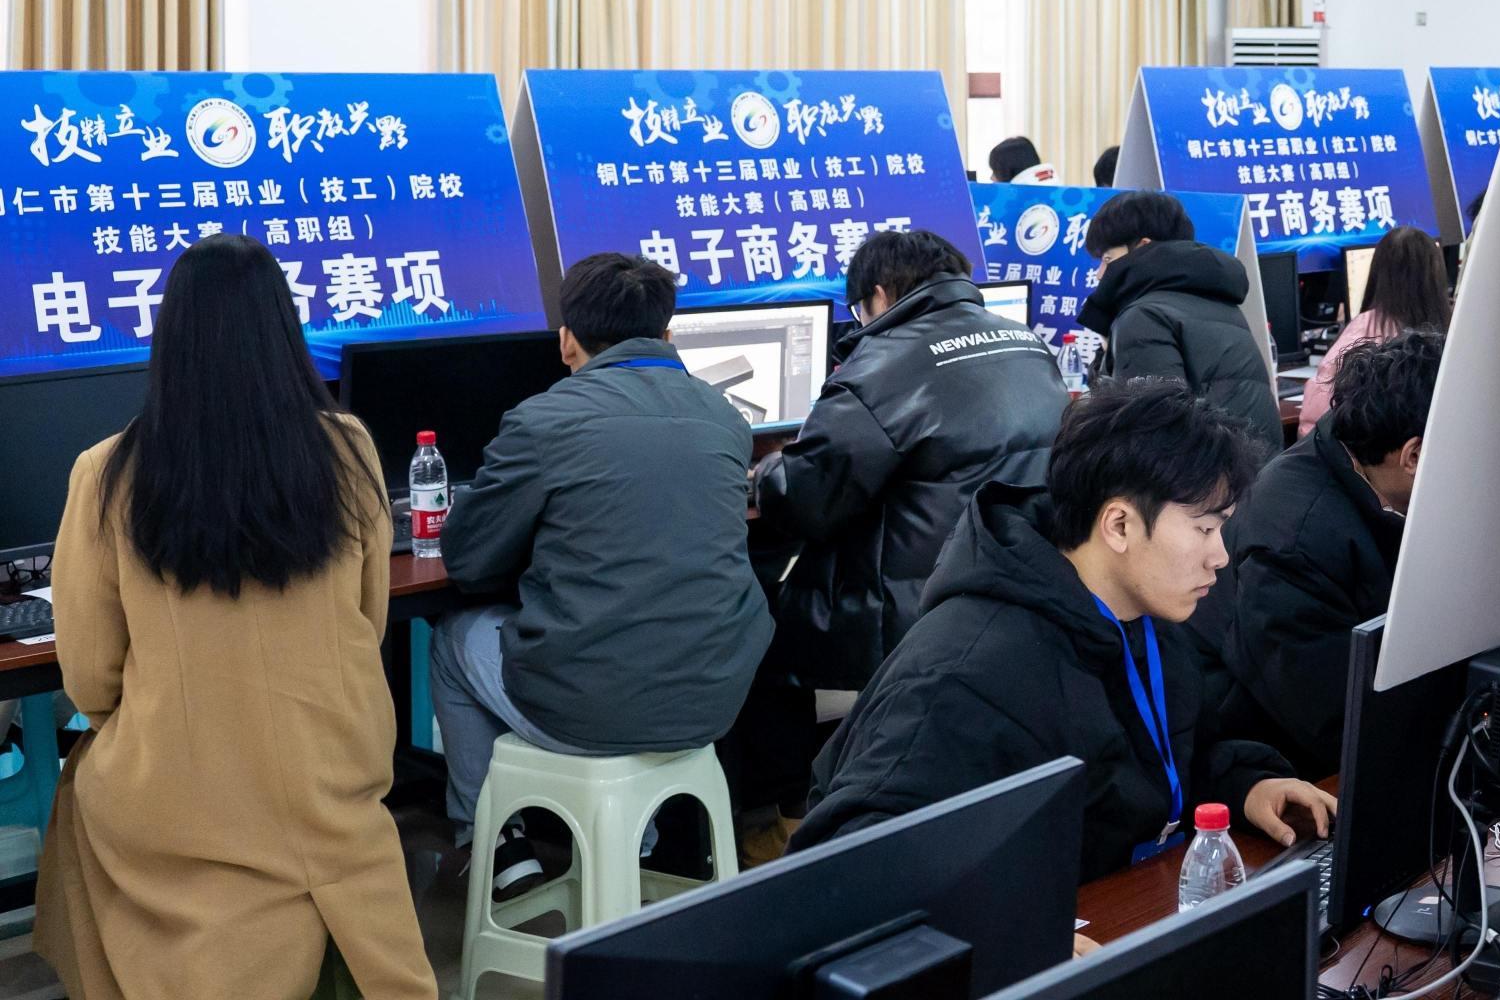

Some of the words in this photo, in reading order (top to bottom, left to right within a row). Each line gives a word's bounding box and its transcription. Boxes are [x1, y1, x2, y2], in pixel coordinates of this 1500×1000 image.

[1187, 134, 1398, 159] 铜仁市第十三届职业（技工）院校
[596, 152, 926, 187] 铜仁市第十三届职业（技工）院校
[1237, 161, 1359, 185] 技能大赛（高职组）
[0, 172, 464, 216] 仁市第十三届职业（技工）院校
[676, 186, 866, 219] 技能大赛（高职组）
[640, 216, 912, 287] 电子商务赛
